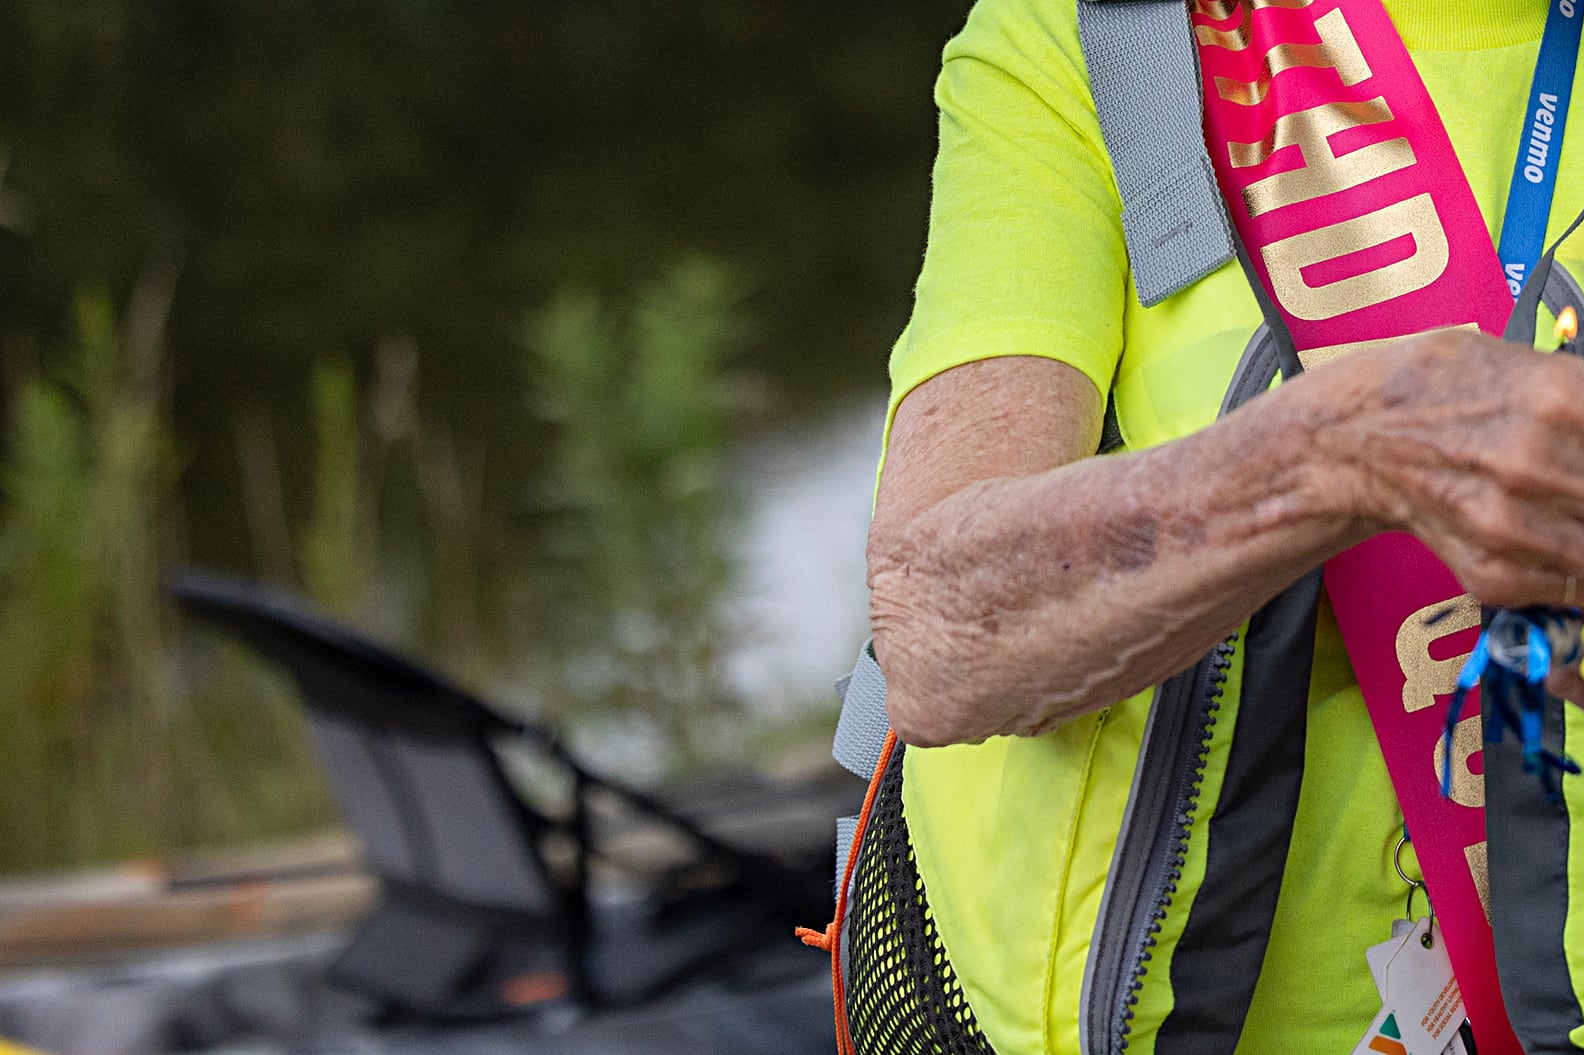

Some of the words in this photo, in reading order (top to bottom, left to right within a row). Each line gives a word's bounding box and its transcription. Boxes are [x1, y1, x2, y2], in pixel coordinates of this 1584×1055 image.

[1523, 92, 1558, 184] venmo
[1421, 1015, 1430, 1027] FOR
[1428, 999, 1440, 1017] YOUTH
[1427, 1021, 1435, 1033] FOR
[1434, 1002, 1448, 1023] HEALTHY
[1432, 1028, 1441, 1040] FOR
[1439, 1013, 1452, 1030] SOCIAL
